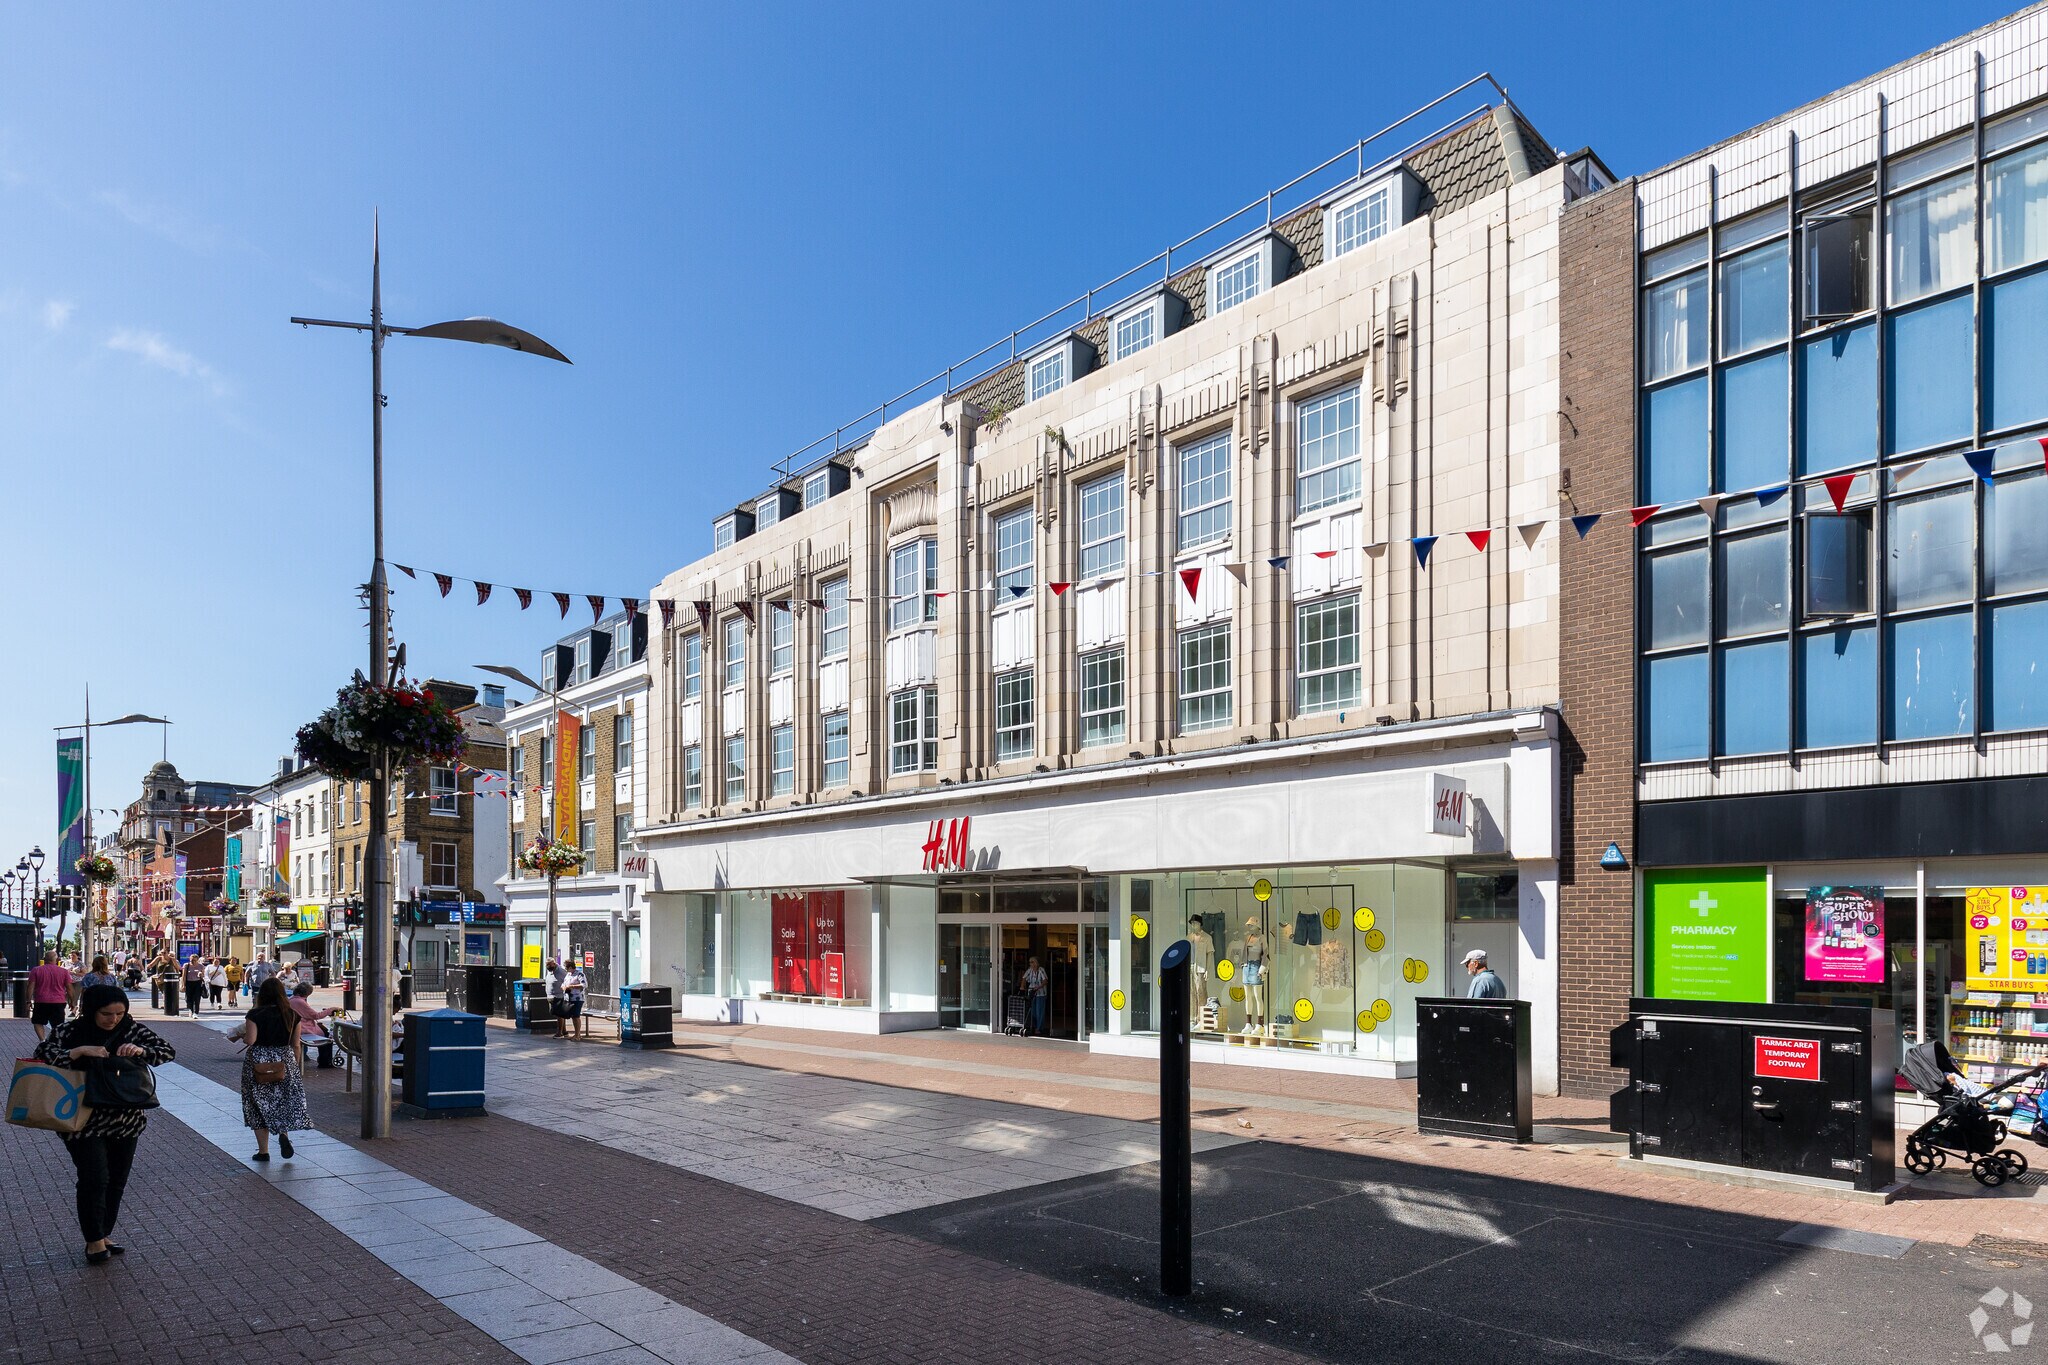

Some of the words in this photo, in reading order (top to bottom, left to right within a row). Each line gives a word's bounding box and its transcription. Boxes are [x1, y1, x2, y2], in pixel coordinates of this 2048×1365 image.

[1437, 788, 1463, 824] H&M
[922, 815, 969, 872] H&M
[624, 856, 646, 872] H&M
[1821, 902, 1866, 914] SUPER
[1831, 910, 1874, 922] SHOW
[817, 917, 826, 929] Up
[827, 918, 834, 928] to
[781, 928, 795, 938] Sale
[1671, 926, 1737, 935] PHARMACY
[818, 934, 833, 943] 50%
[786, 942, 791, 952] is
[785, 959, 793, 967] on
[1989, 980, 2010, 988] STAR
[2012, 980, 2034, 989] BUYS
[1761, 1039, 1793, 1048] TARMAC
[1763, 1049, 1810, 1059] TEMPORARY
[1768, 1060, 1806, 1068] FOOTWAY
